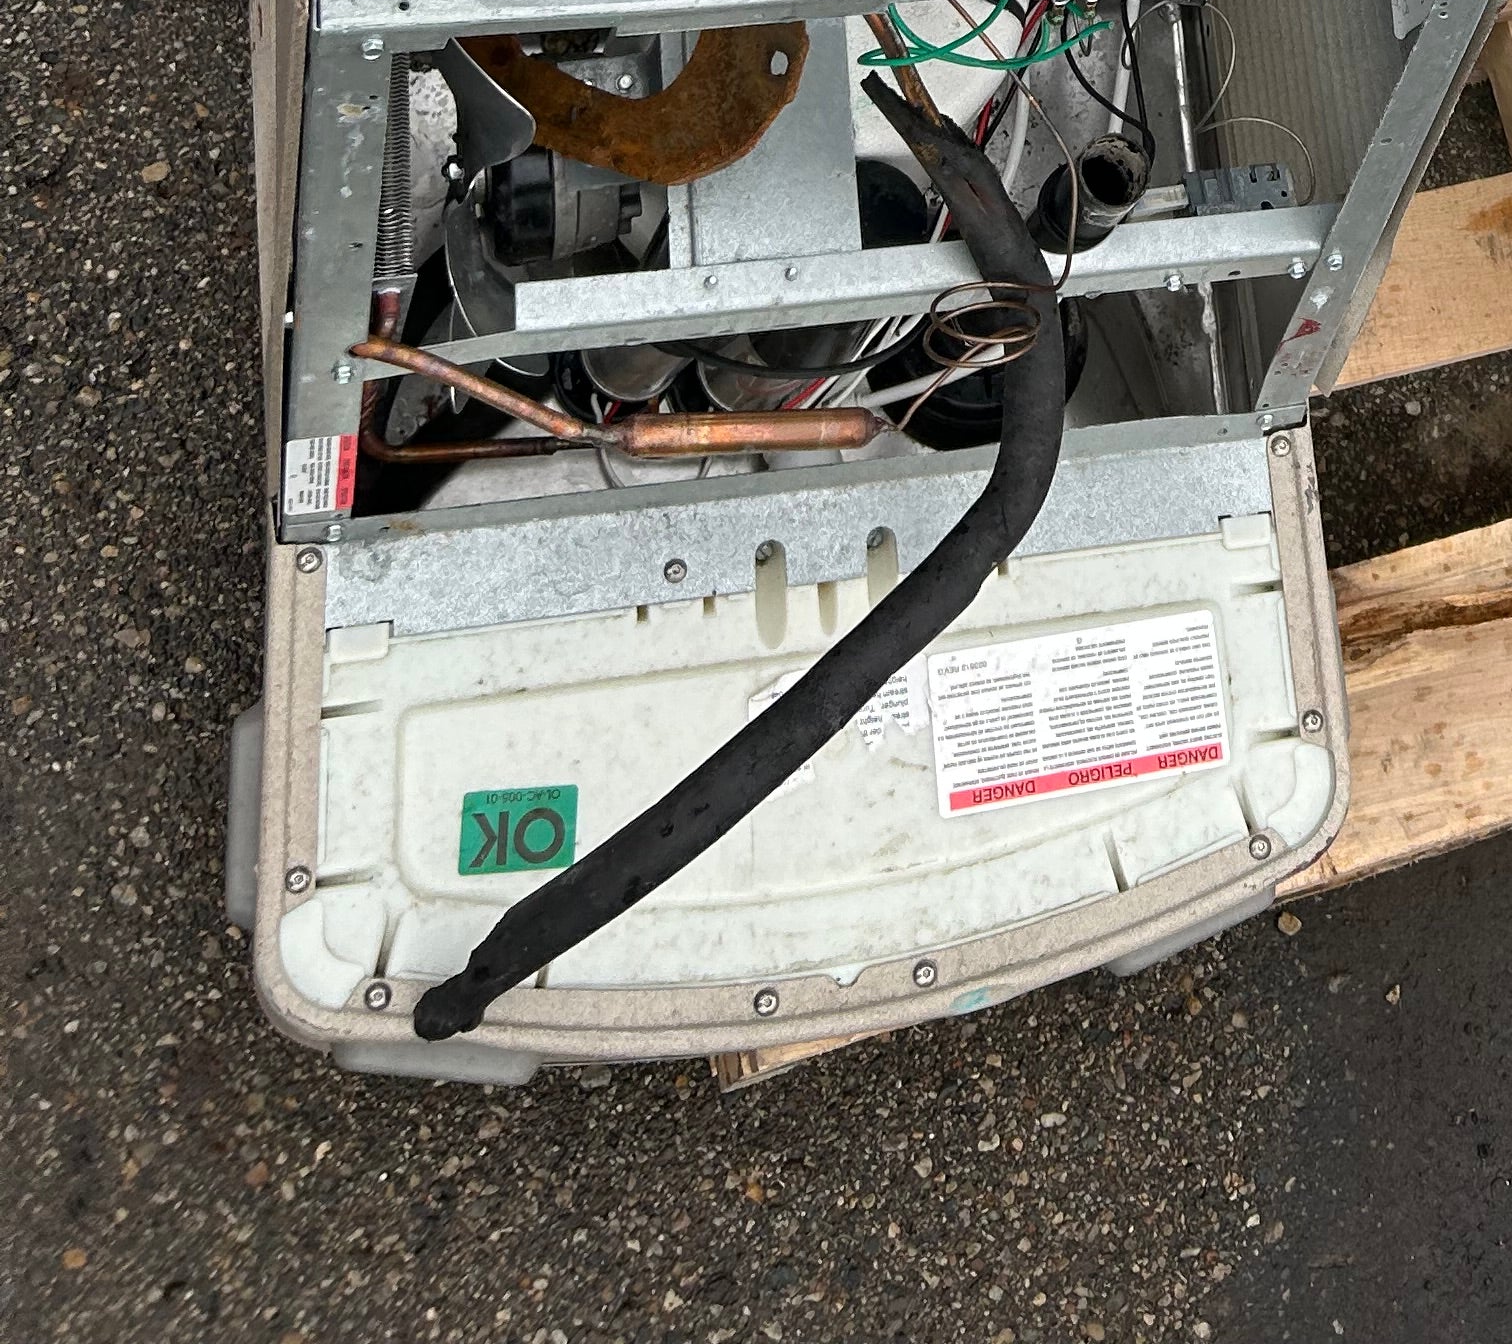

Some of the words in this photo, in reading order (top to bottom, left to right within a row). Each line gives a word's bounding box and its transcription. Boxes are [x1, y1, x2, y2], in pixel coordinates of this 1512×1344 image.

[1157, 746, 1217, 768] DANGER
[1068, 763, 1131, 785] PELIGRO
[972, 780, 1035, 803] DANGER
[468, 807, 566, 868] OK
